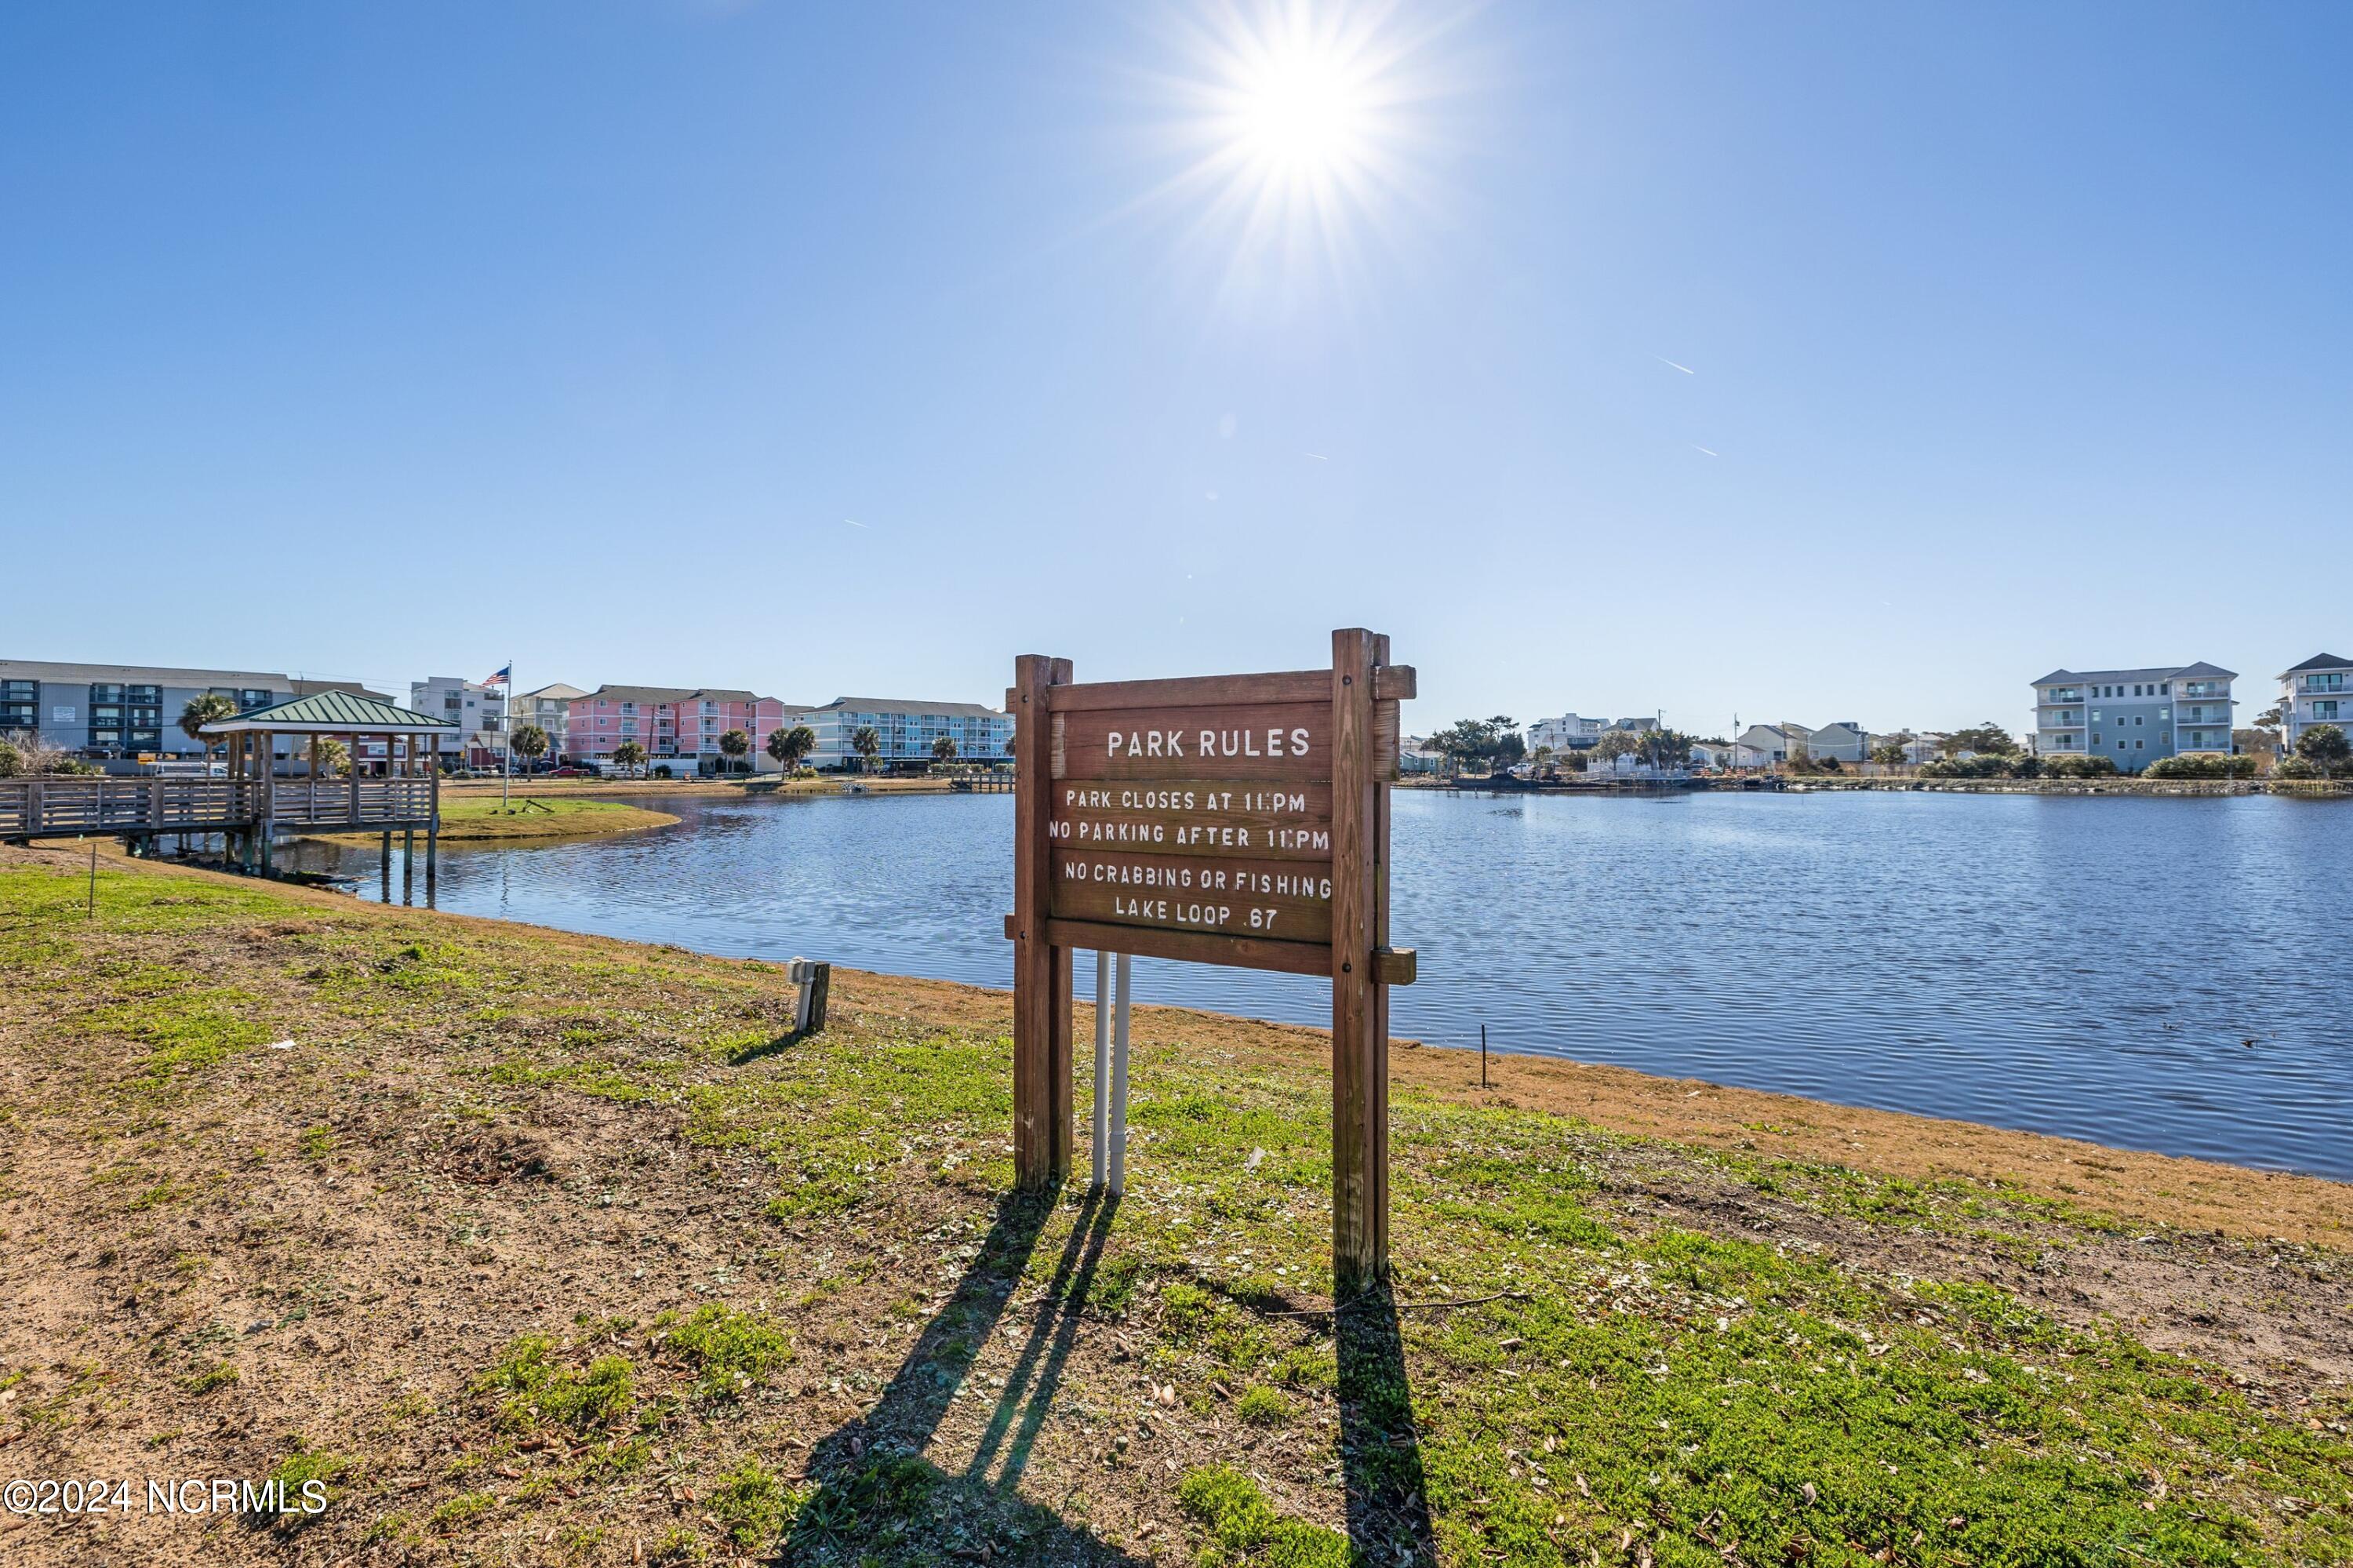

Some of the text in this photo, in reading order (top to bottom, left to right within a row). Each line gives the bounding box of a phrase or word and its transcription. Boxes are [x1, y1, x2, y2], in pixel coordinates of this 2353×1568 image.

[1107, 728, 1311, 758] PARK RULES
[1066, 790, 1111, 808] PARK
[1122, 791, 1195, 809] CLOSES
[1207, 792, 1232, 810] AT
[1049, 820, 1071, 839] NO
[1079, 822, 1164, 842] PARKING
[1176, 826, 1249, 847] AFTER
[1065, 862, 1332, 900] NO CRABBING OR FISHING
[1115, 897, 1278, 930] LAKE LOOP 67
